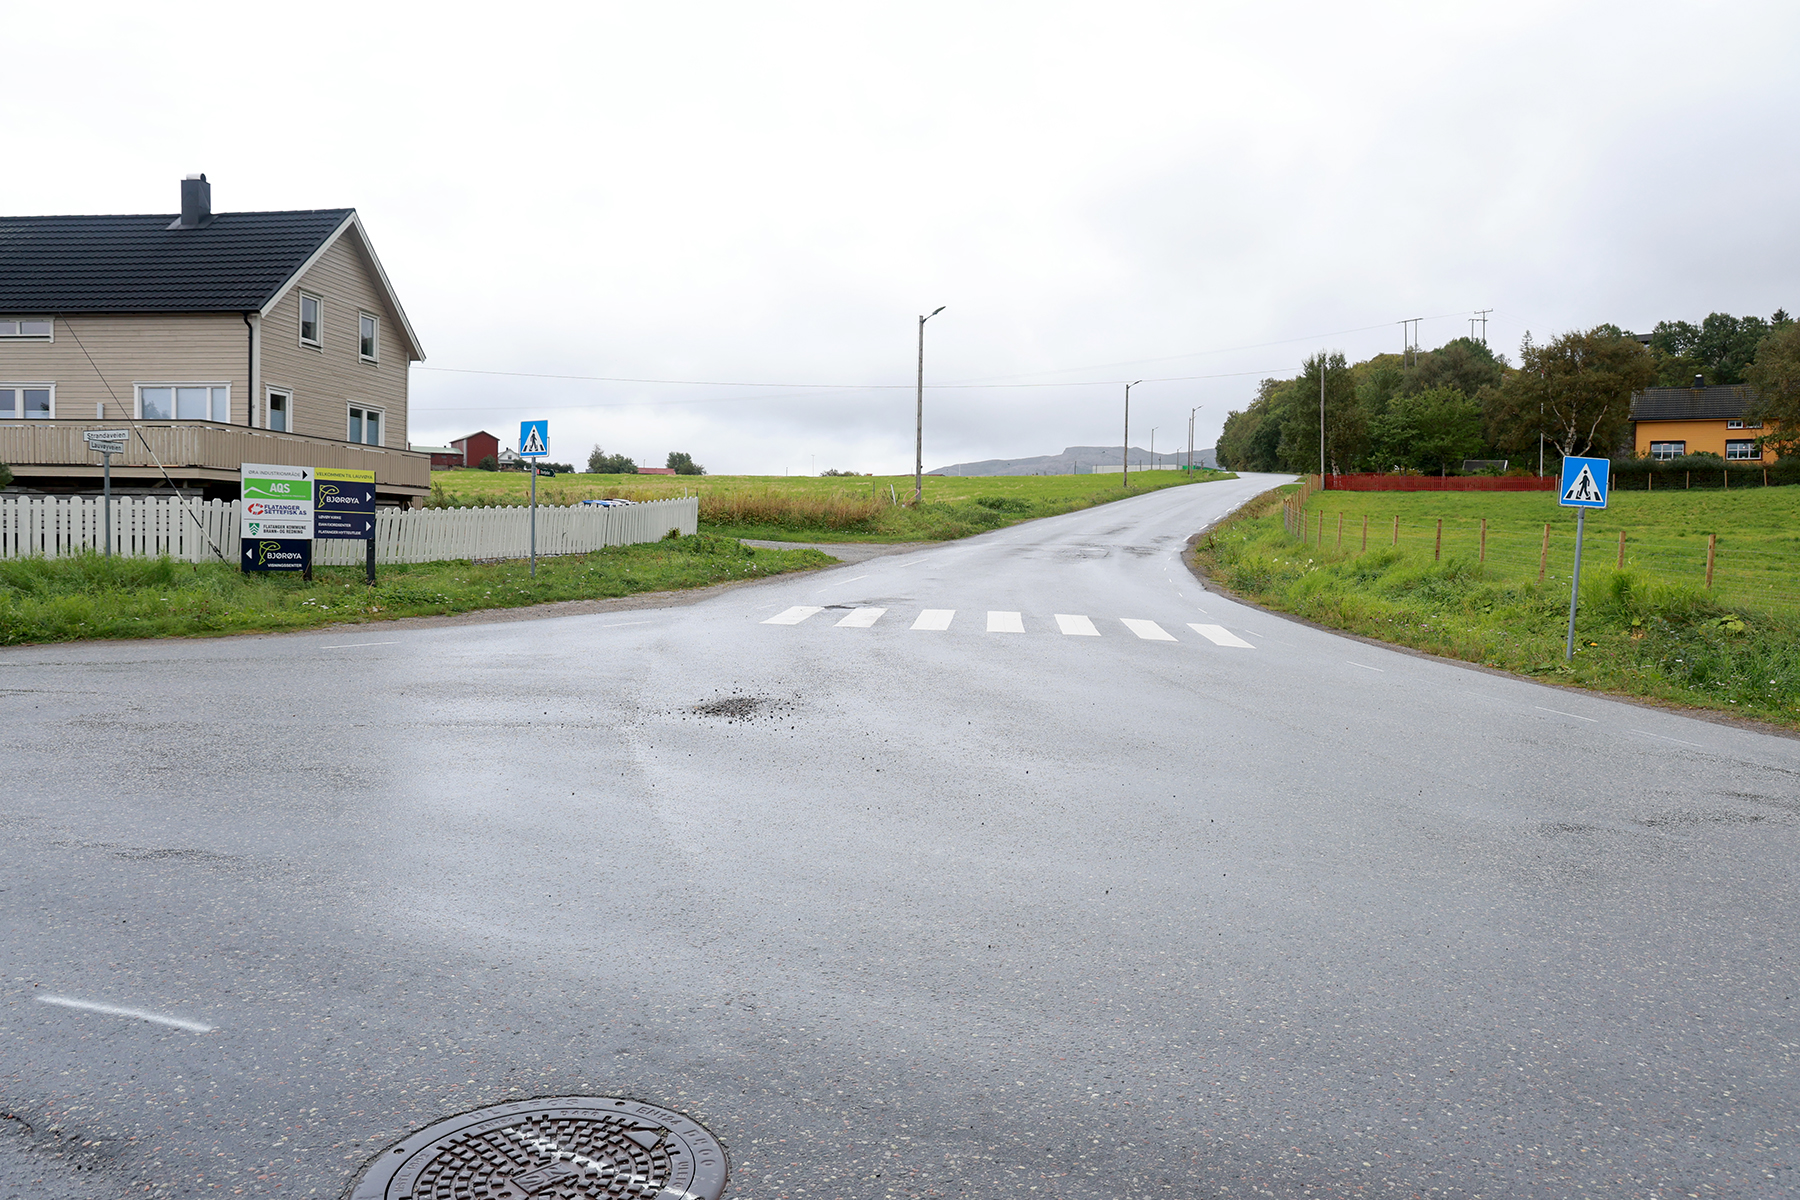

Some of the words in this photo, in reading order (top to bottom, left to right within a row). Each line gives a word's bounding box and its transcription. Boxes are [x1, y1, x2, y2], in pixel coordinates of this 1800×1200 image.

[269, 483, 291, 493] AQS
[326, 496, 360, 504] BJØRØYA
[468, 1098, 579, 1120] ULEFOS
[635, 1106, 683, 1126] EN124
